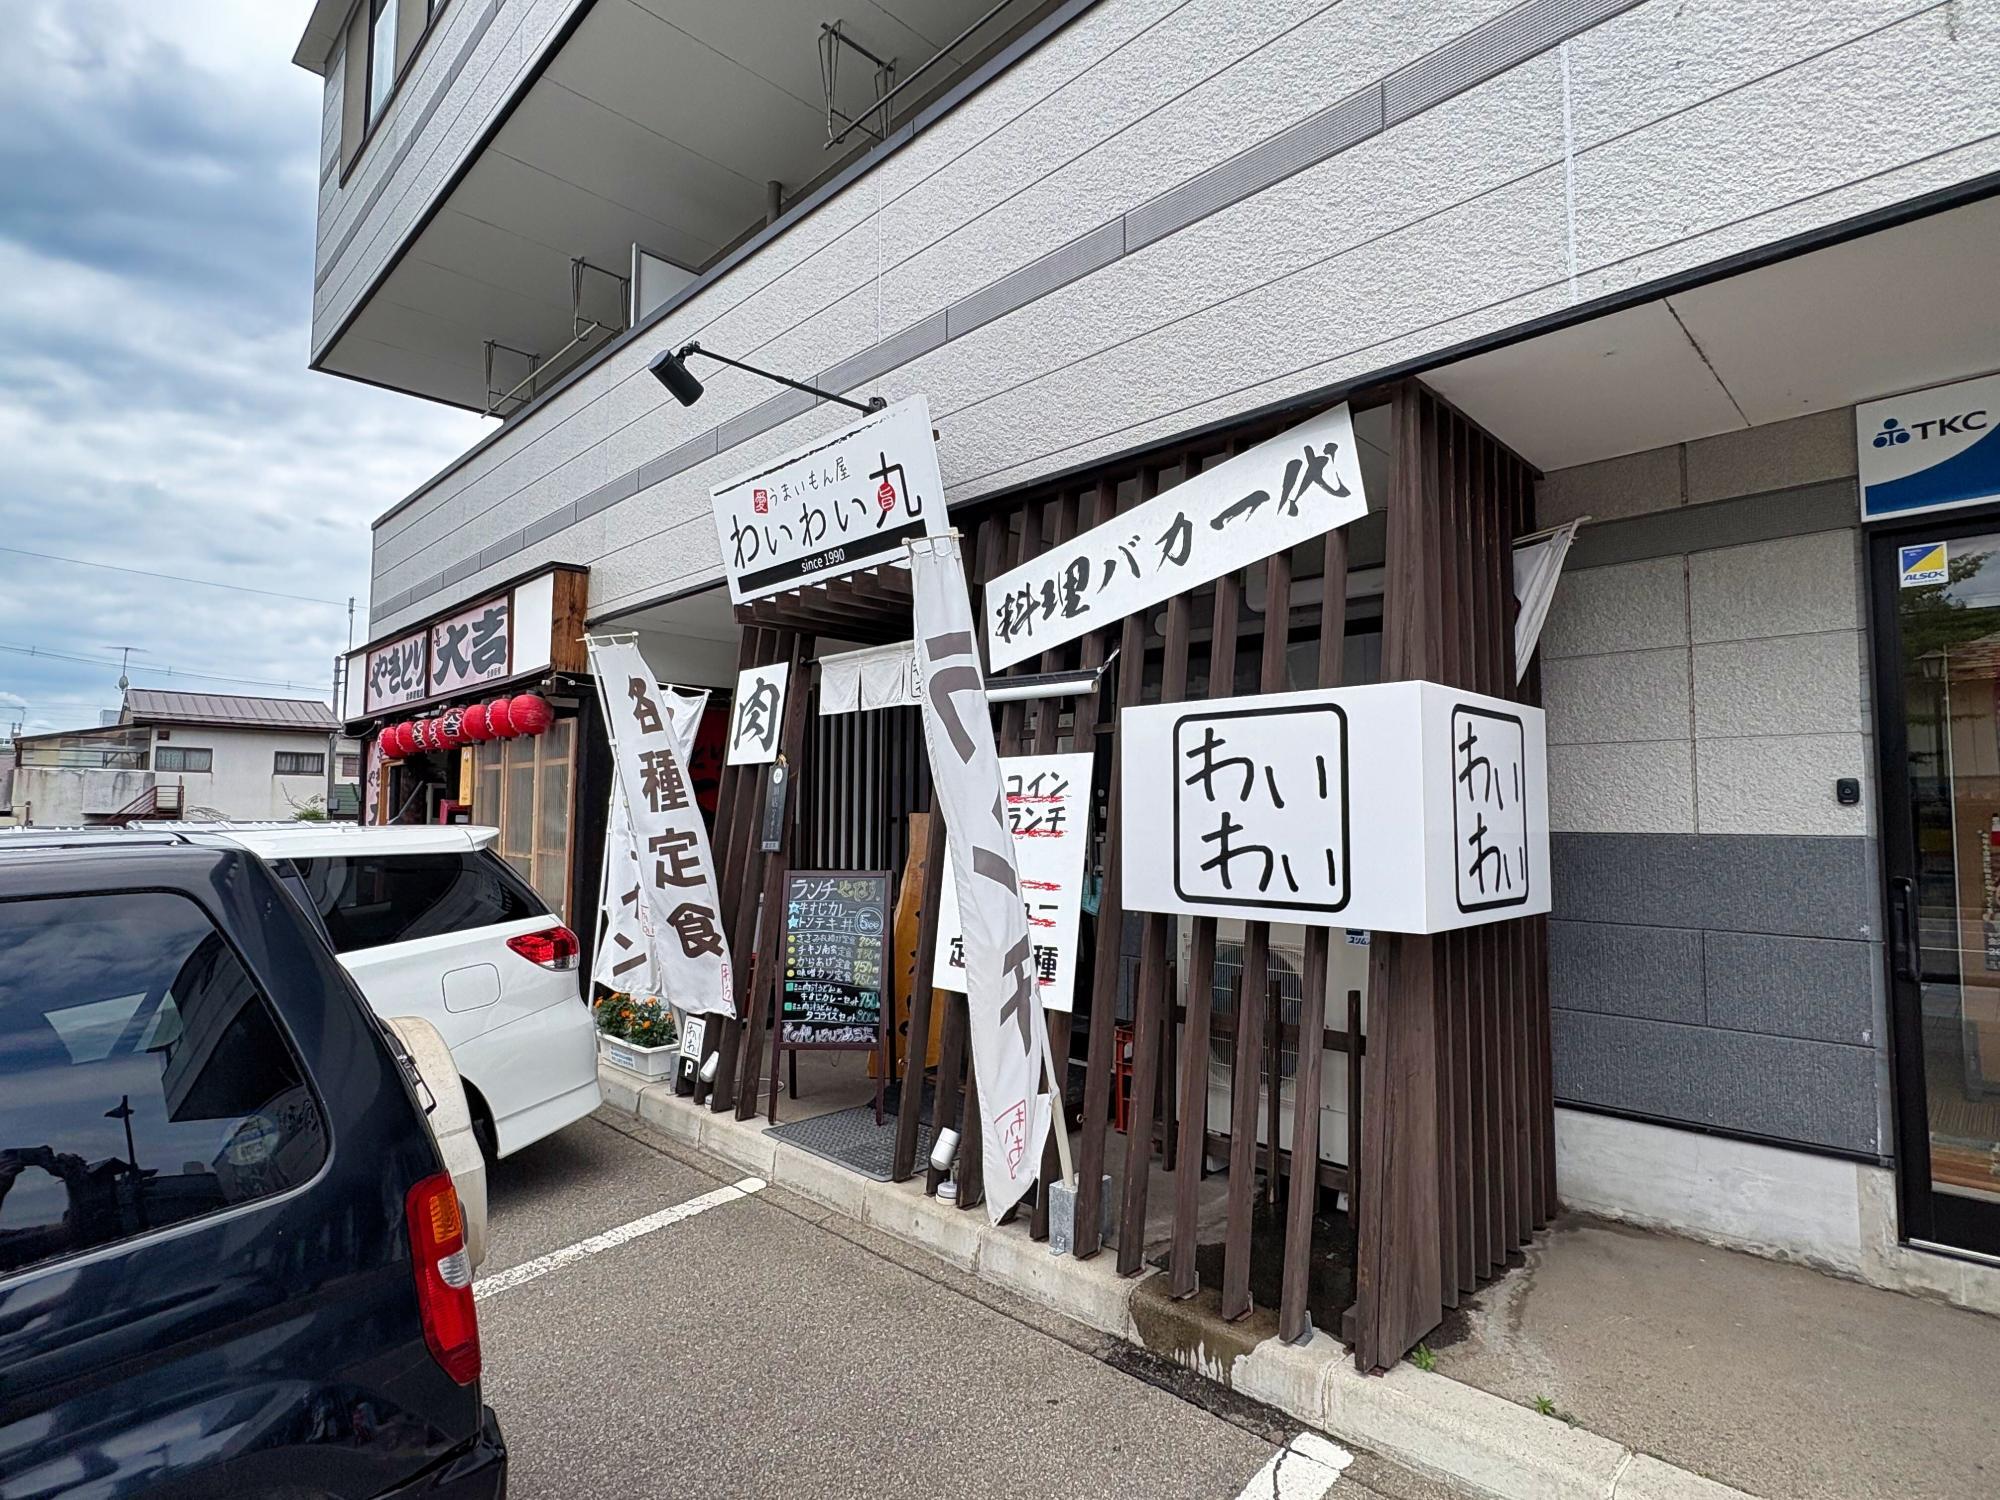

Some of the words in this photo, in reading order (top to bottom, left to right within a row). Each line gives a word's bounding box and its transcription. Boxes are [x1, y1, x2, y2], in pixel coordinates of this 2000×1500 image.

[1912, 410, 1987, 440] TKC
[730, 451, 922, 569] わいわい丸
[768, 456, 851, 506] うまいもん屋
[801, 556, 823, 573] since
[824, 548, 845, 568] 1990
[995, 441, 1352, 645] 料理バカ一代
[1904, 571, 1944, 580] ALSOK
[370, 637, 426, 698] やきとり
[433, 605, 507, 686] 大吉
[733, 677, 780, 753] 肉
[1185, 727, 1328, 809] わい
[1459, 721, 1519, 811] わい
[627, 674, 724, 960] 各種定食
[1200, 811, 1336, 892] わい
[1468, 812, 1524, 894] わい
[799, 901, 857, 917] 牛すじカレー
[685, 1060, 694, 1077] P
